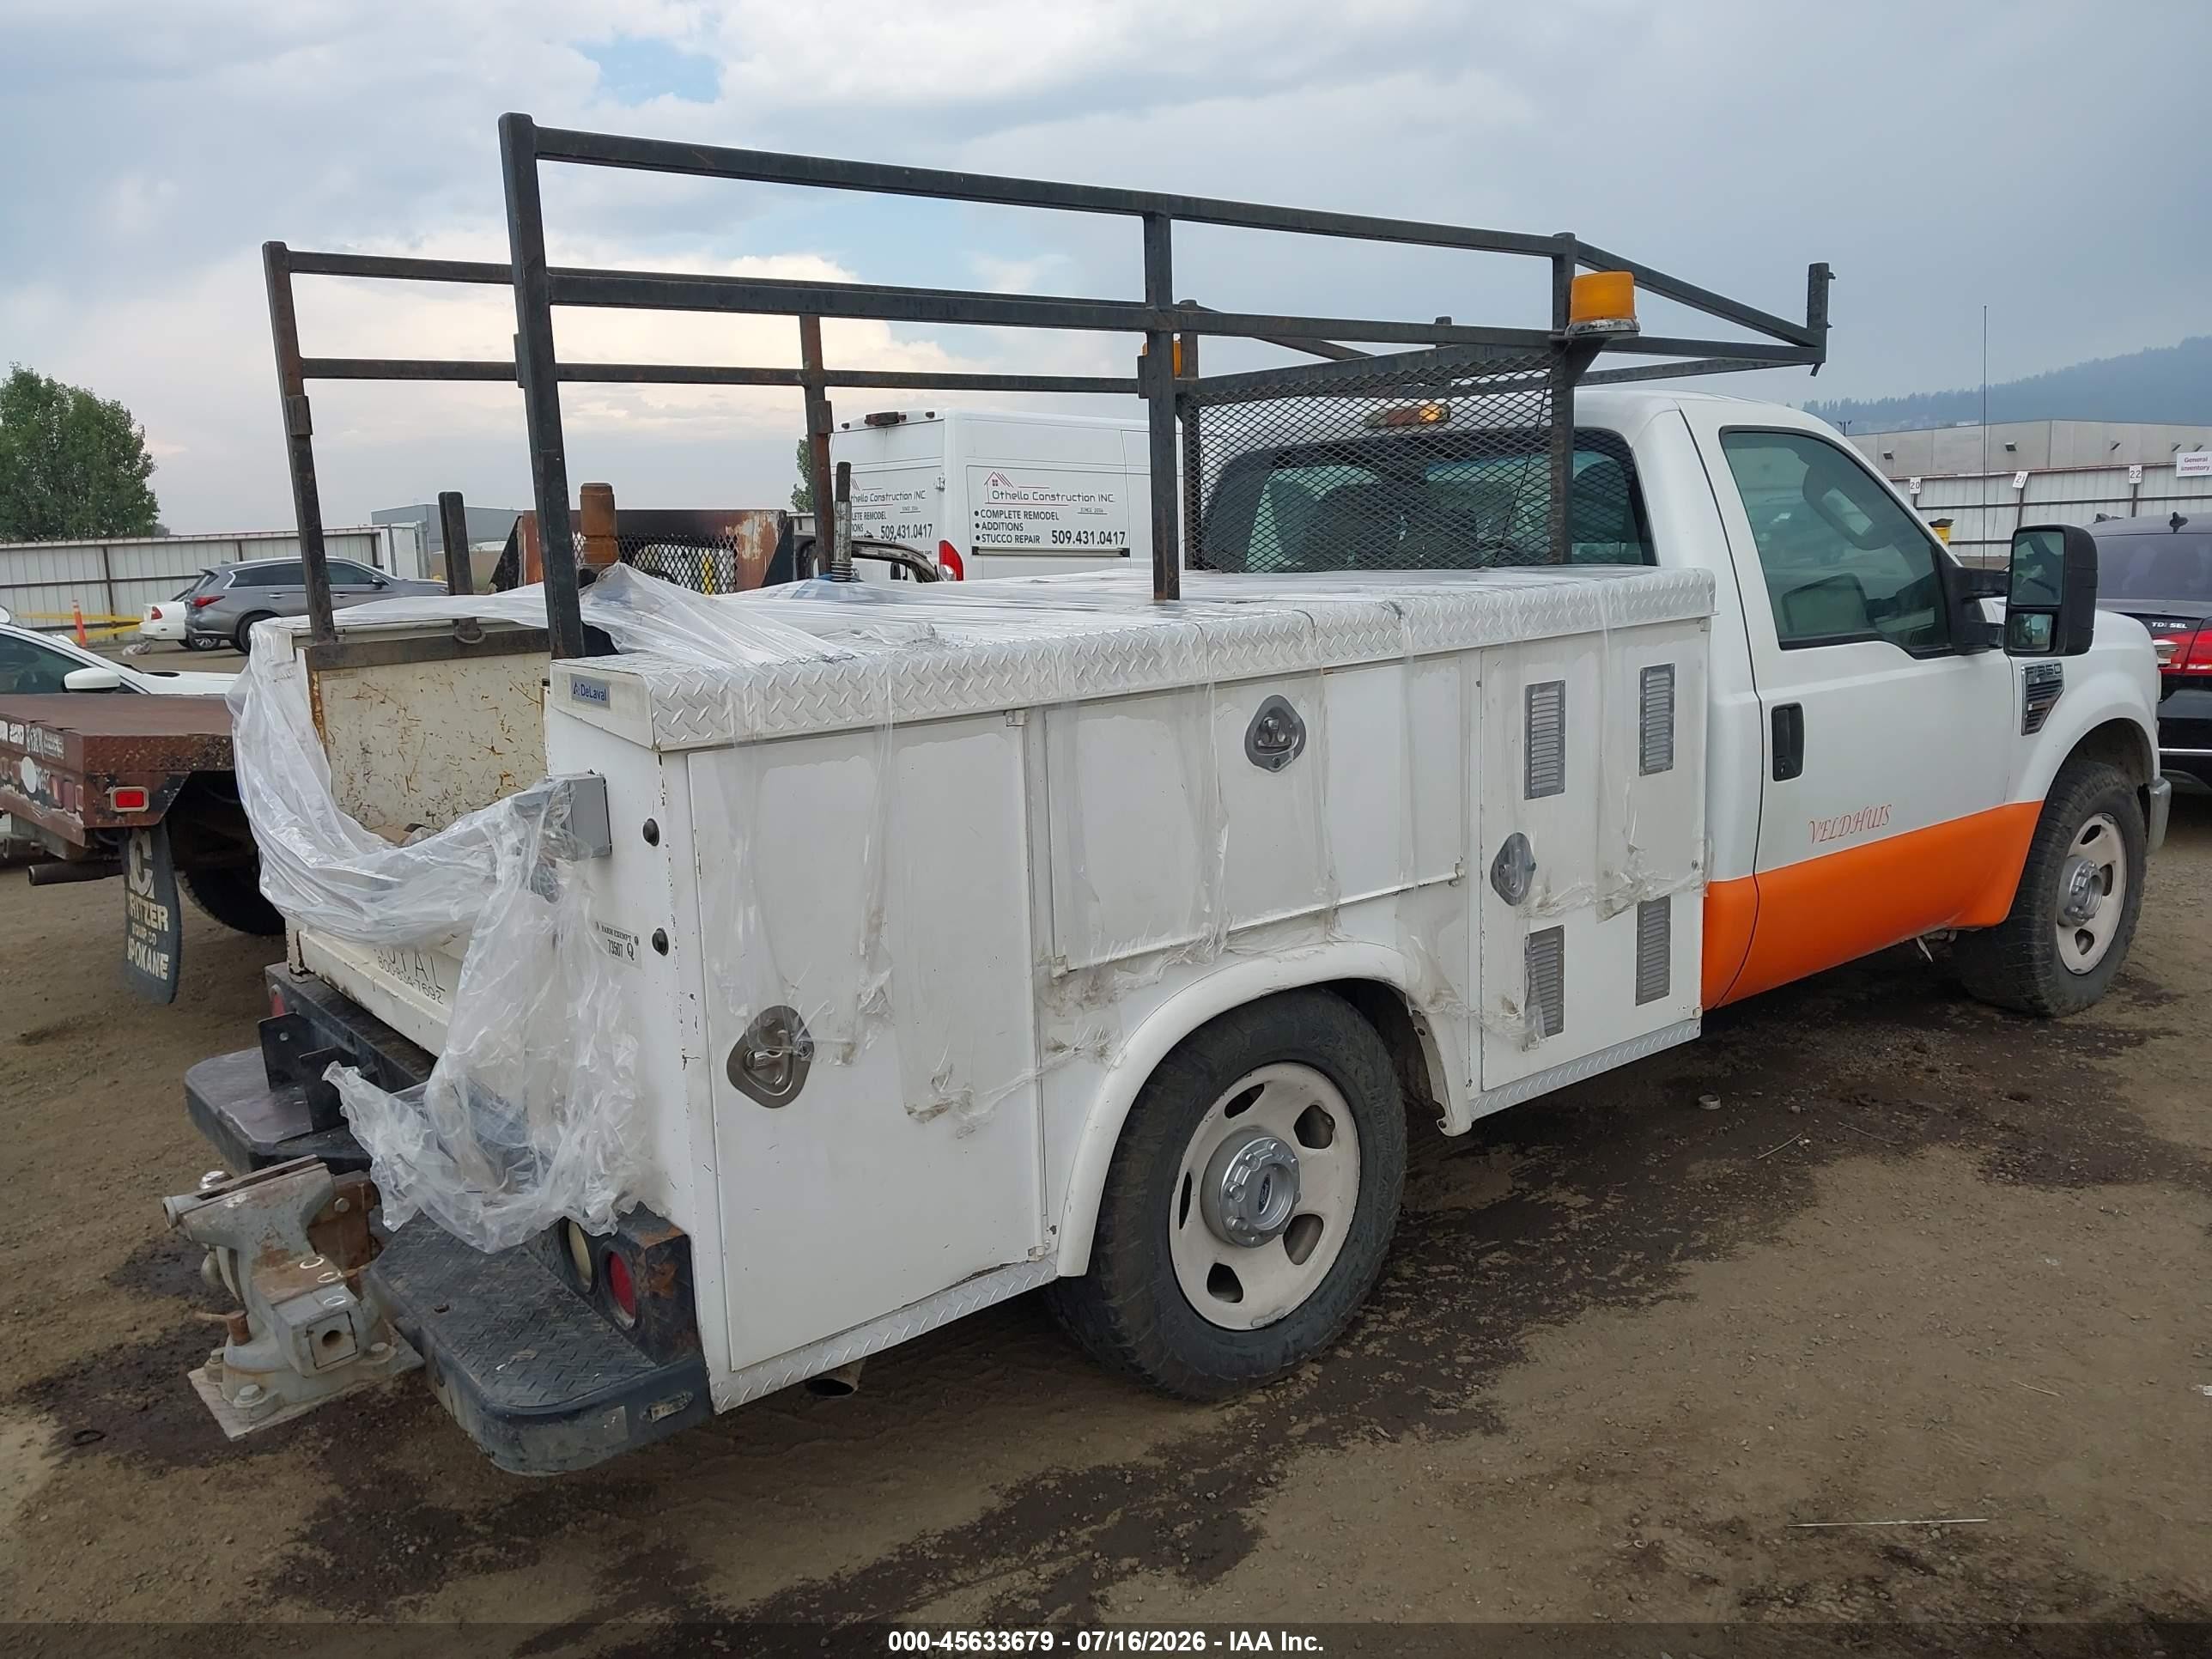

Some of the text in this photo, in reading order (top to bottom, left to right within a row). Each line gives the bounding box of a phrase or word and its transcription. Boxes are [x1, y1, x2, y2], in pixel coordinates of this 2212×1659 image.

[2015, 475, 2026, 483] 21
[2130, 470, 2142, 478] 22
[1910, 481, 1920, 489] 20
[870, 492, 912, 502] Construction
[914, 490, 927, 500] INC
[992, 489, 1115, 502] Othello Construction INC
[852, 510, 886, 520] LETE REMODEL
[980, 509, 1060, 520] COMPLETE REMODEL
[880, 523, 933, 540] 509.431.0417
[981, 521, 1024, 532] ADDITIONS
[981, 534, 1040, 544] STUCCO REPAIR
[1051, 530, 1126, 545] 509.431.0417
[580, 684, 607, 702] DeLaval
[1808, 804, 1892, 844] VELDHUIS
[128, 934, 169, 980] SPOKANE
[627, 942, 635, 961] Q
